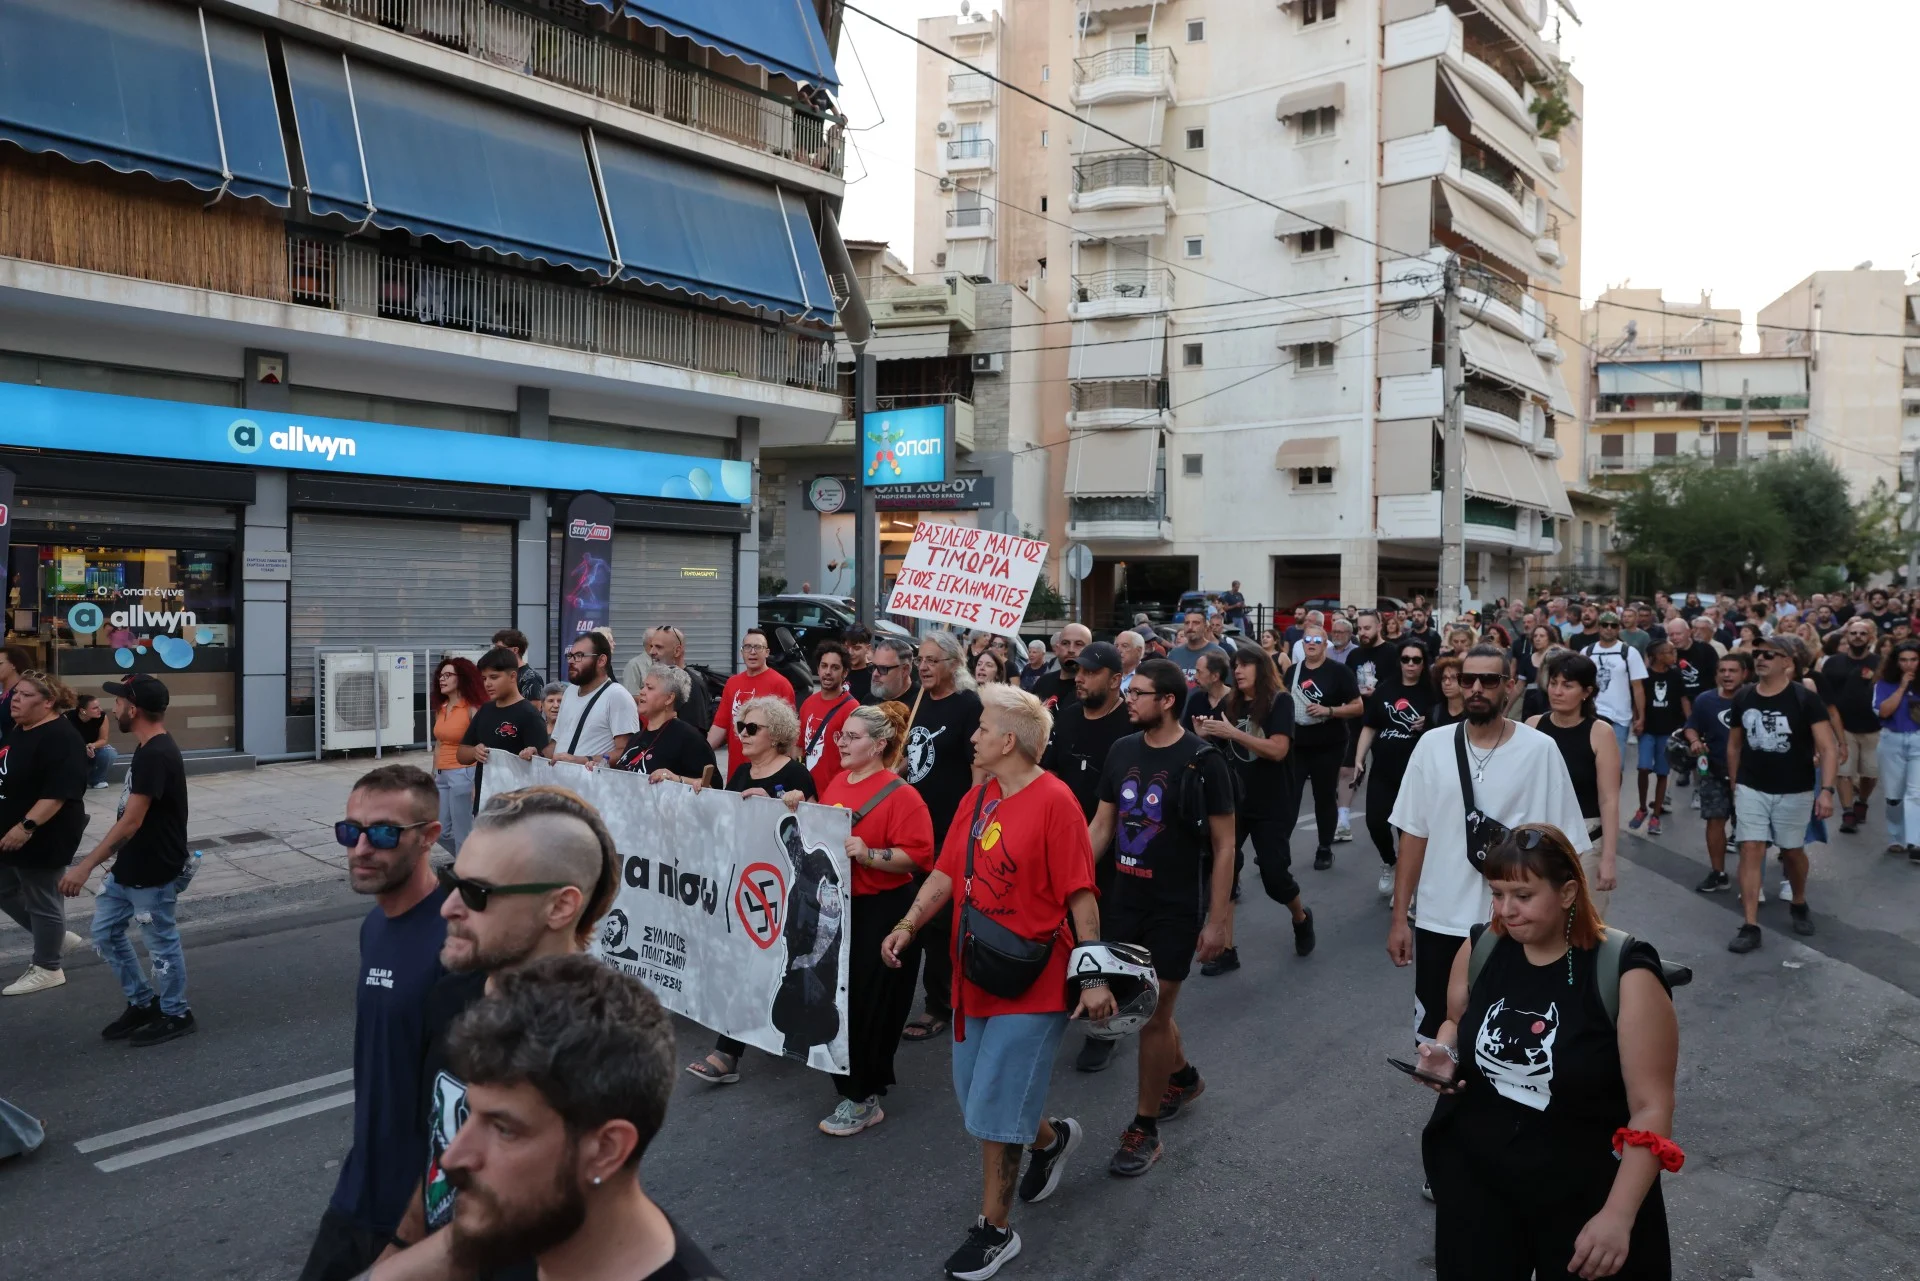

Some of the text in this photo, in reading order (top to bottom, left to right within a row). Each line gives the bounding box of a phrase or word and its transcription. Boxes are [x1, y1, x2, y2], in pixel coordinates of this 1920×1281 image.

[269, 426, 356, 461] allwyn
[895, 438, 941, 457] οπαπ
[913, 521, 1047, 563] ΒΑΣΙΛΕΙΟΣ ΜΑΓΓΟΣ
[928, 545, 1010, 579] ΤΙΜΩΡΙΑ
[122, 588, 152, 597] οπαπ
[154, 586, 185, 600] έγινε
[895, 567, 1029, 609] ΣΤΟΥΣ ΕΓΚΛΗΜΑΤΙΕΣ
[110, 604, 197, 633] allwyn
[891, 591, 1021, 629] ΒΑΣΑΝΙΣΤΕΣ ΤΟΥ
[1120, 854, 1137, 867] RAP
[658, 857, 718, 916] πίσω
[643, 925, 687, 954] ΣΥΛΛΟΓΟΣ
[641, 944, 687, 972] ΠΟΛΙΤΙΣΜΟΥ
